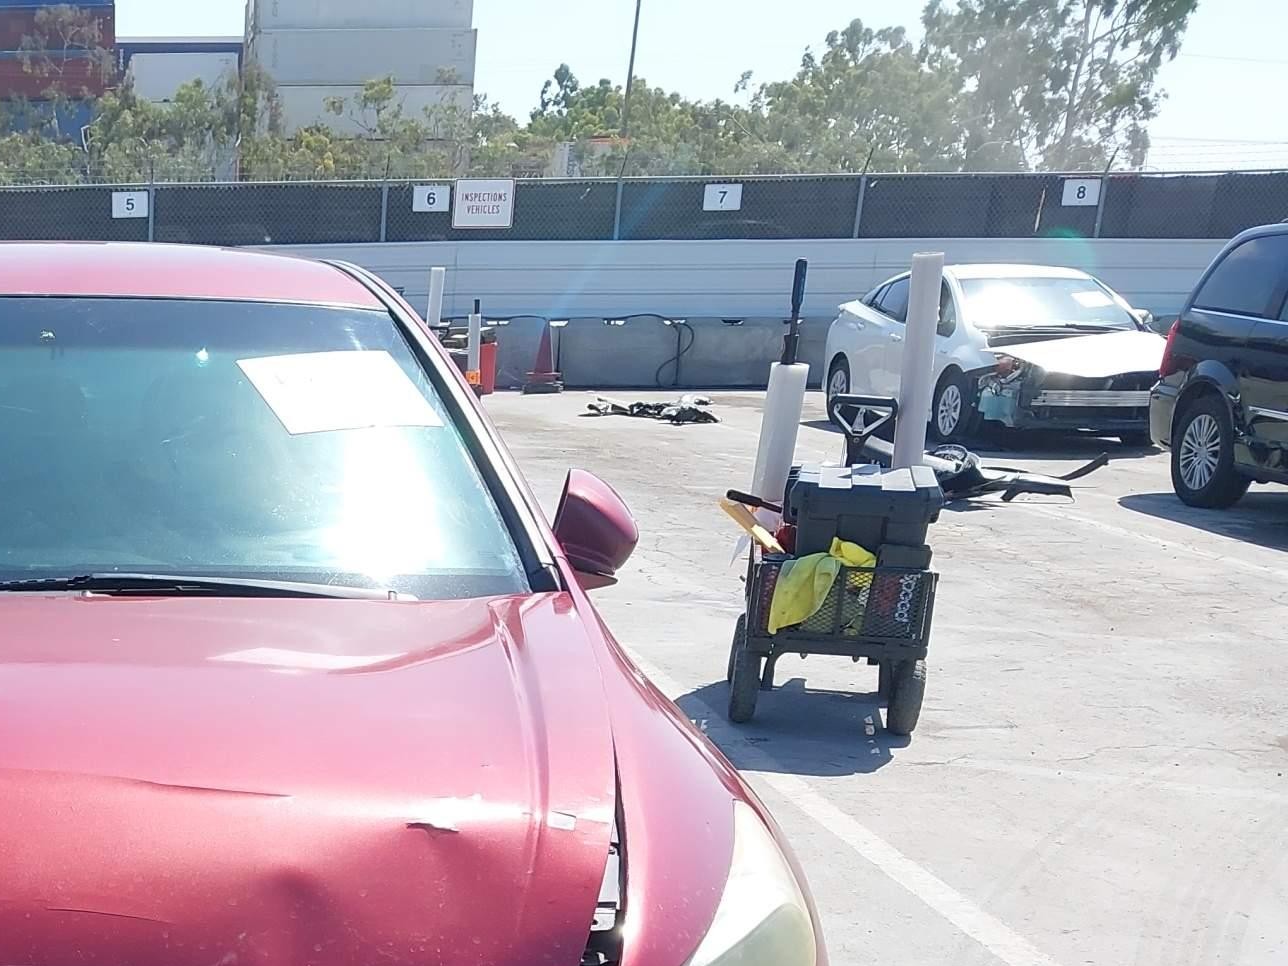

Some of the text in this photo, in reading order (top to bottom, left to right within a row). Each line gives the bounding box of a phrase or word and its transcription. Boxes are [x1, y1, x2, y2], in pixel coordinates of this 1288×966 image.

[426, 192, 436, 205] 6
[461, 192, 508, 202] INSPECTIONS
[718, 191, 728, 204] 7
[1077, 186, 1086, 199] 8
[126, 198, 135, 211] 5
[466, 204, 501, 214] VEHICLES
